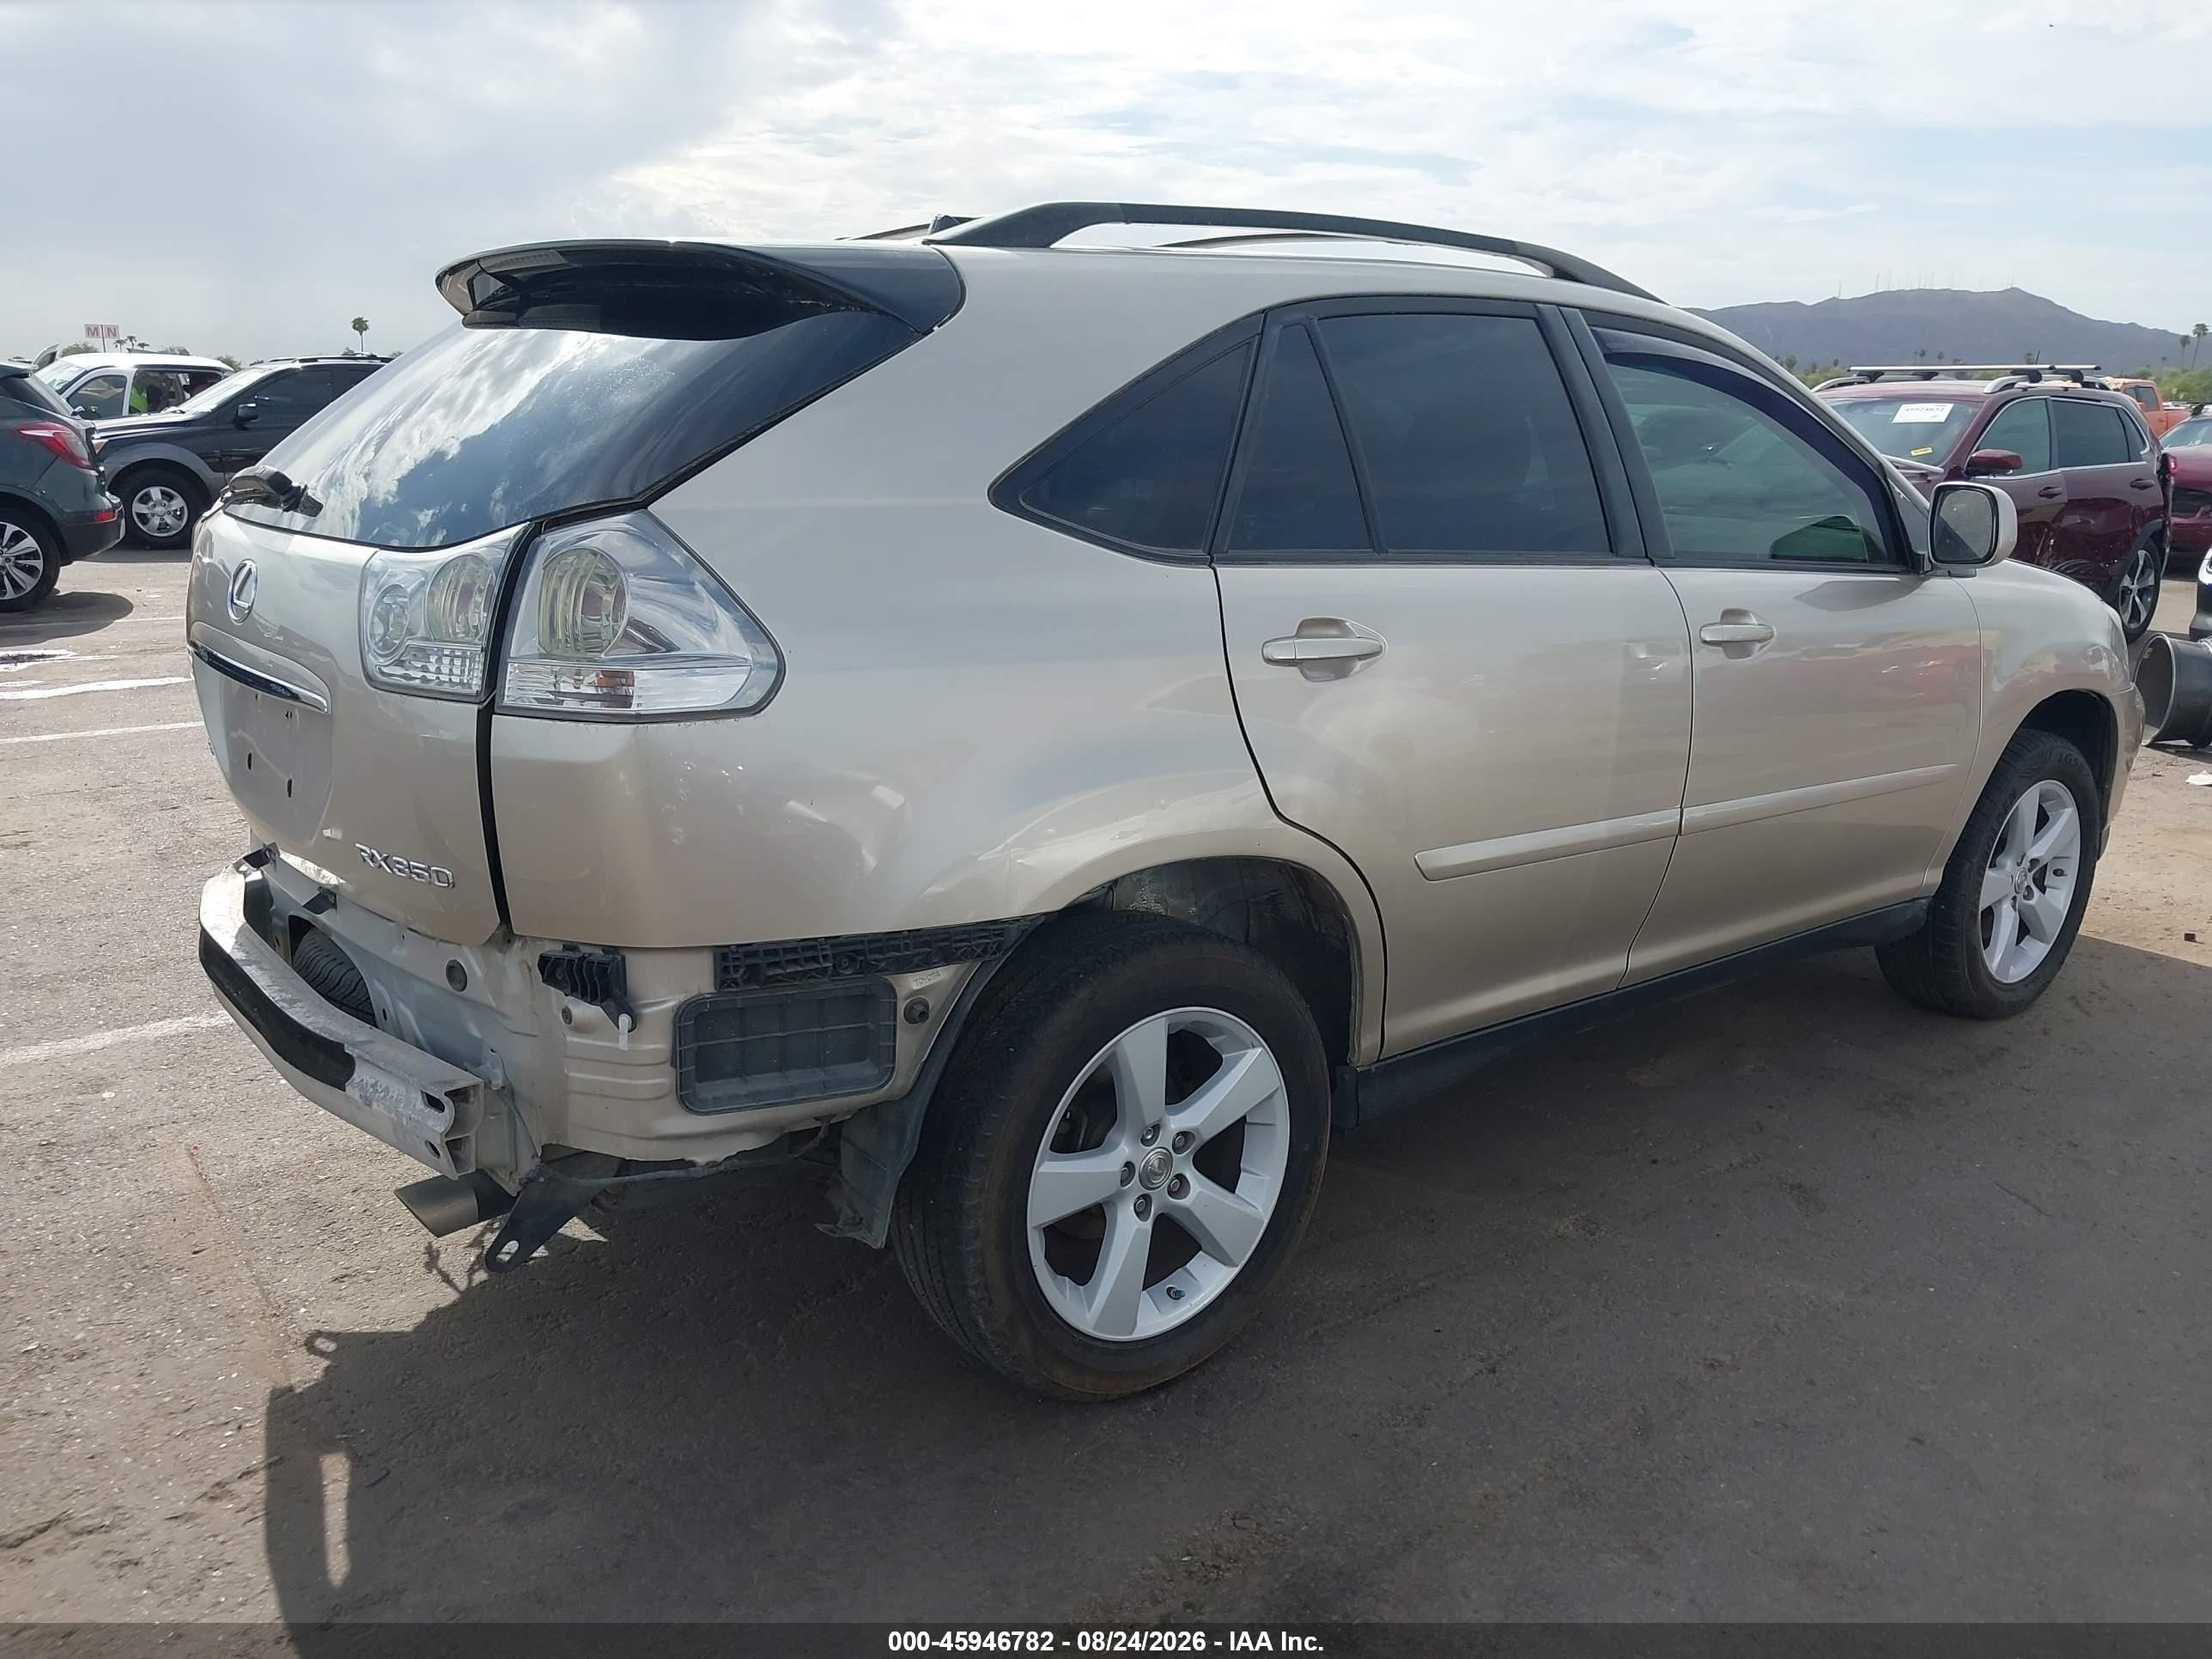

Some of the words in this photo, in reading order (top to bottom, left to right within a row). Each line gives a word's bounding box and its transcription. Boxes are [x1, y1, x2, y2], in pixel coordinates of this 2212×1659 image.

[87, 326, 99, 337] M
[106, 327, 117, 337] N
[354, 842, 455, 889] RX350
